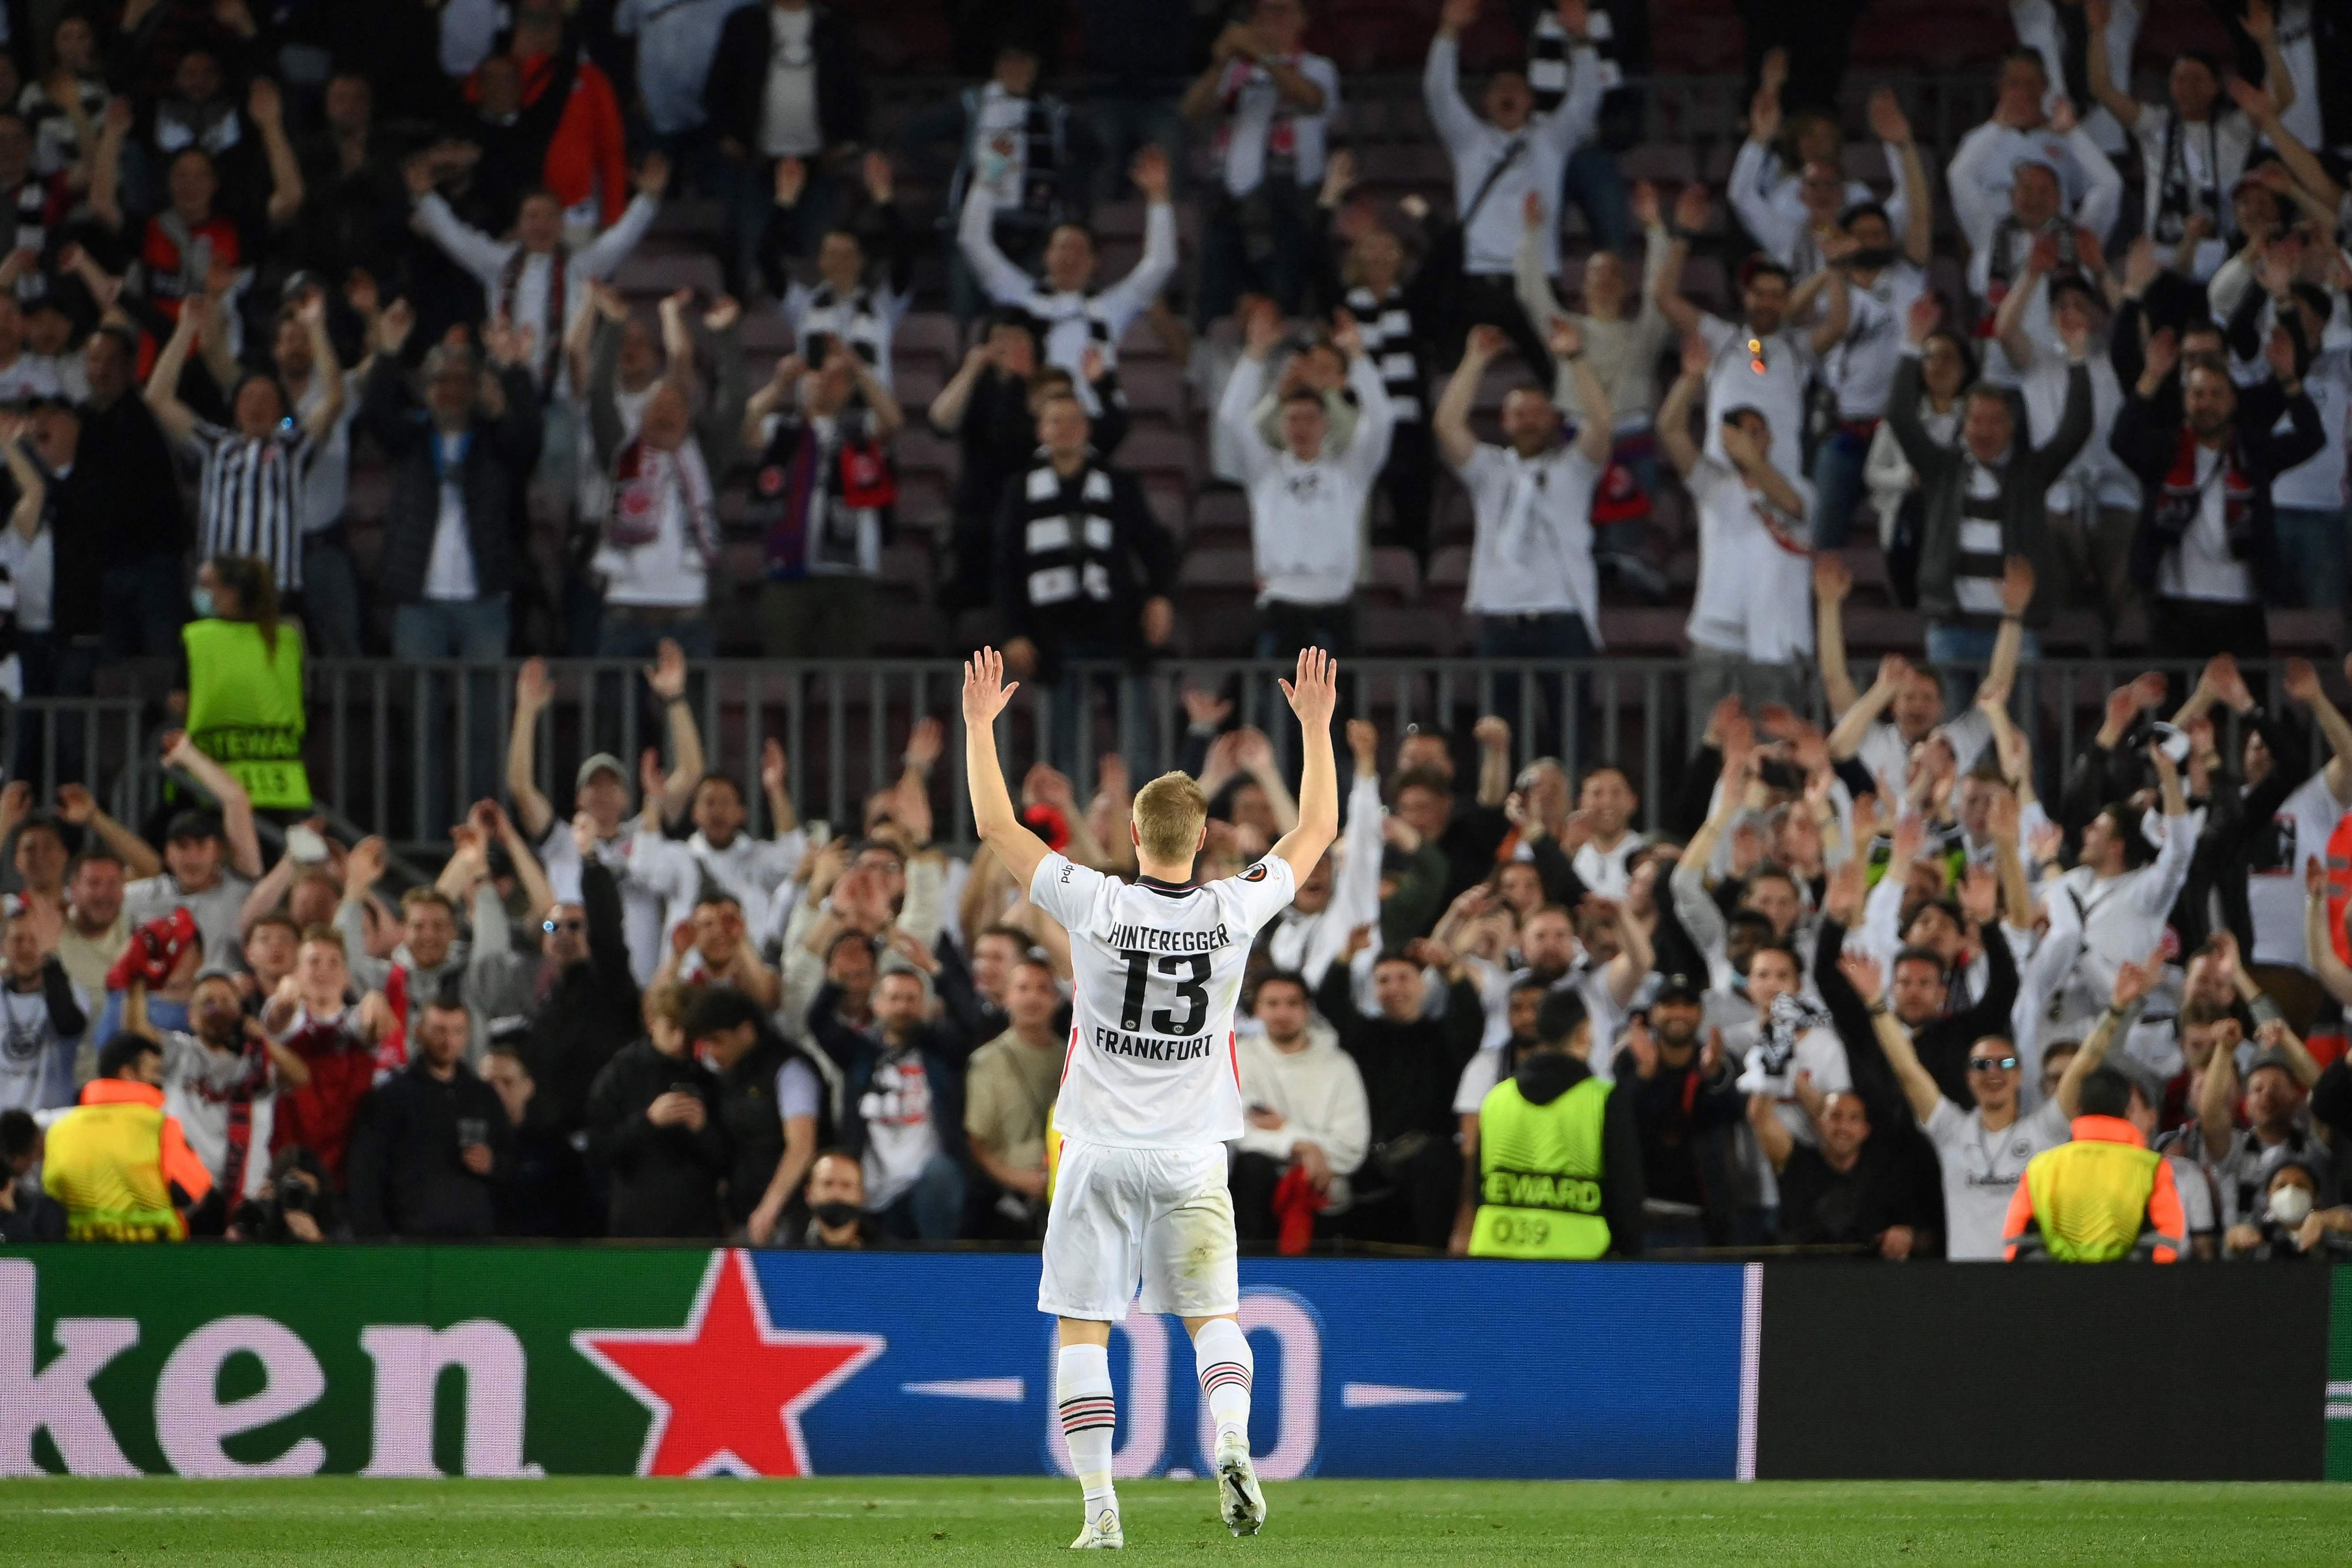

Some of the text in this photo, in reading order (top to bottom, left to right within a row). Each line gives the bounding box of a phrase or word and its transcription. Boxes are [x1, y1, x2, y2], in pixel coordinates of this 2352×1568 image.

[1108, 921, 1230, 951] HINTEREGGER
[1120, 950, 1211, 1036] 13
[1097, 1027, 1212, 1061] FRANKFURT
[1482, 1172, 1602, 1212] EWARD
[0, 1257, 547, 1478] ken
